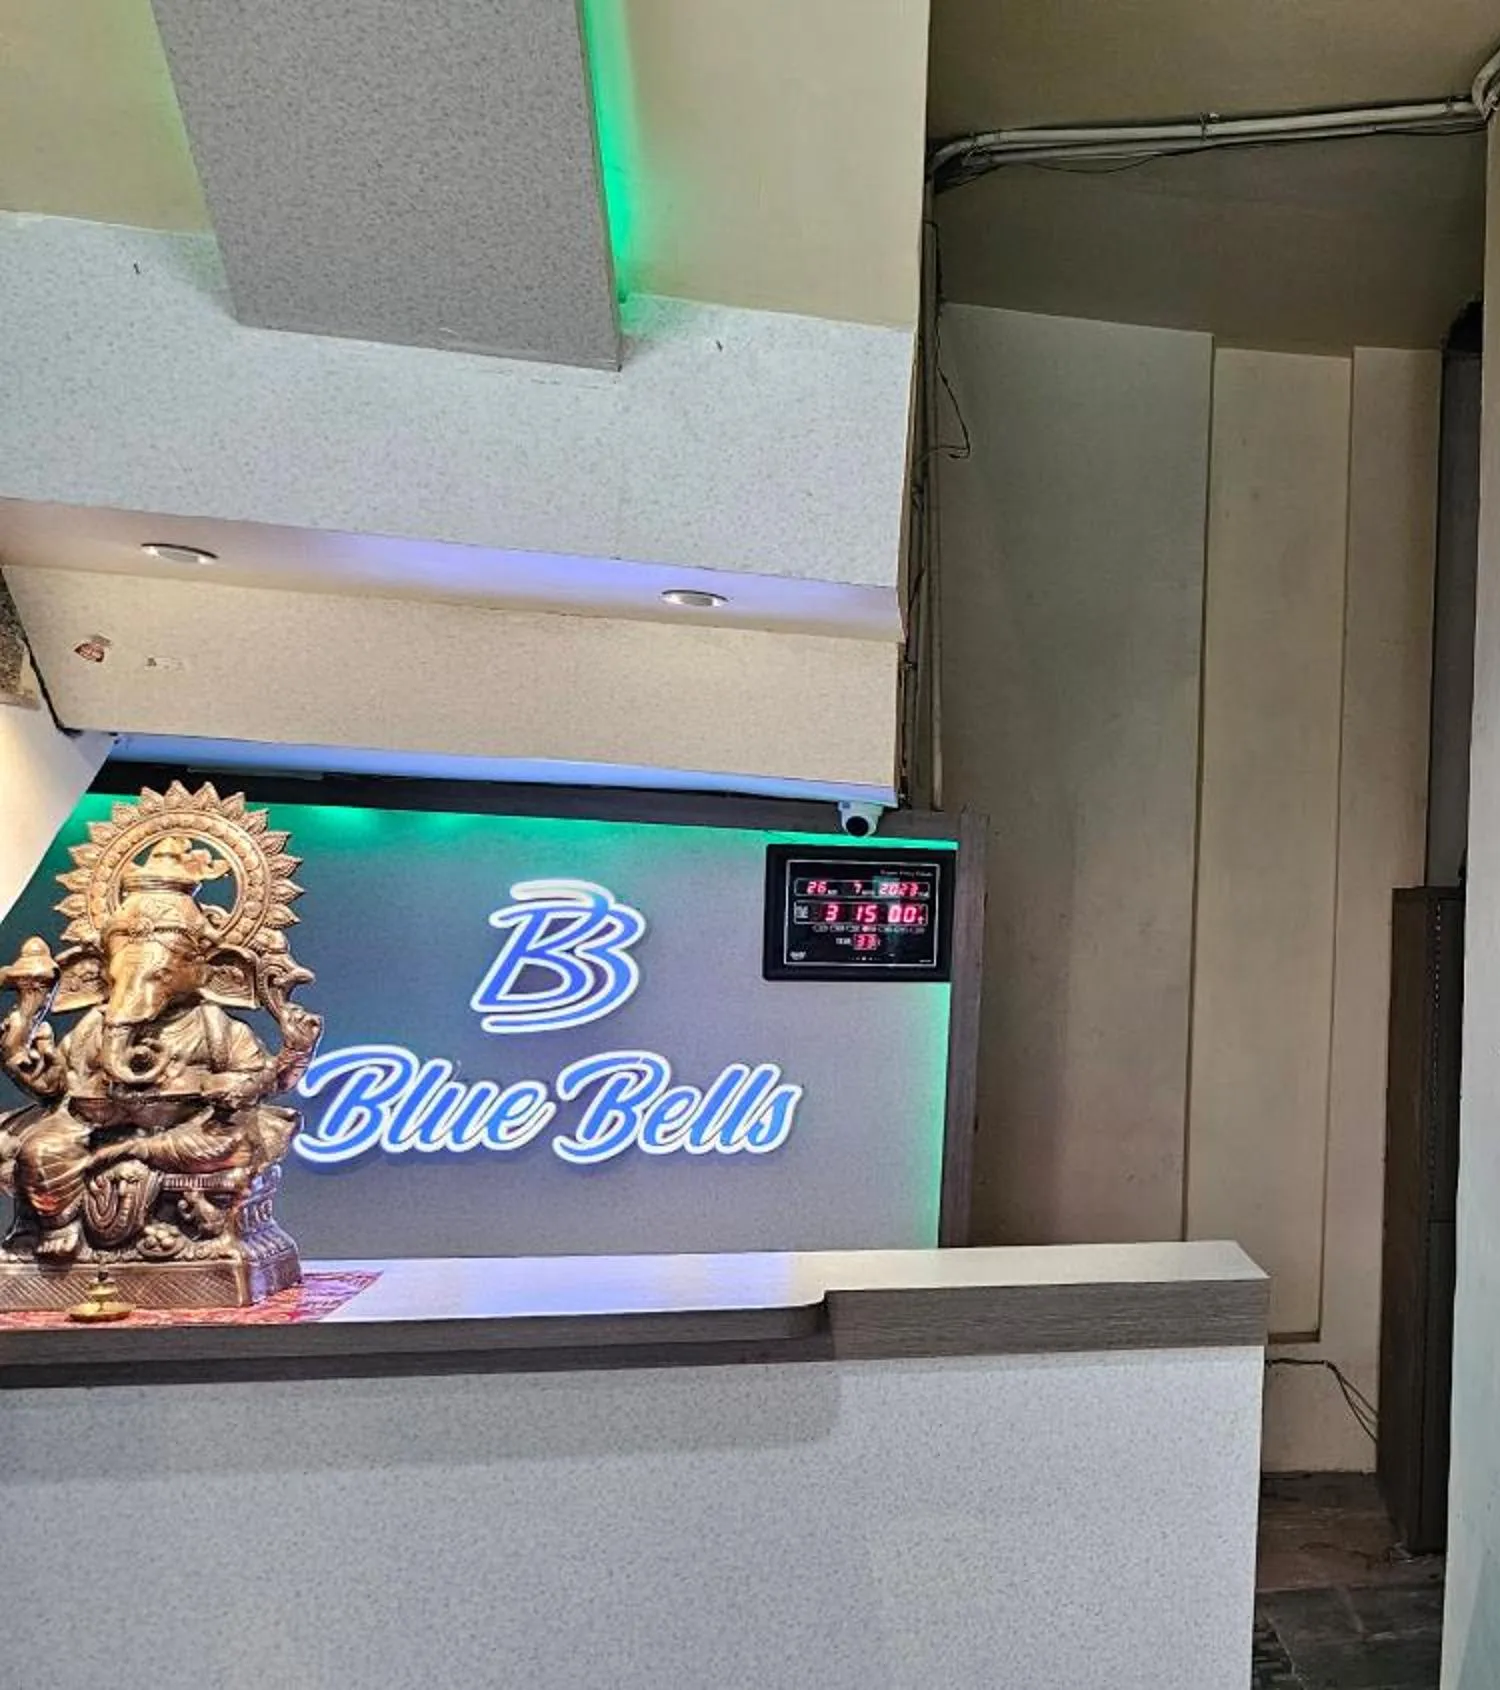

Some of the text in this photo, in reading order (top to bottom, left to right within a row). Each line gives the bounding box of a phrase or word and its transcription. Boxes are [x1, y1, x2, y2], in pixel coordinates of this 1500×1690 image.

[806, 881, 828, 894] 26
[854, 882, 862, 894] 7
[879, 882, 919, 897] 2023
[825, 904, 839, 922] 3
[856, 904, 877, 922] 15
[888, 904, 917, 923] 00
[293, 1045, 802, 1164] Blue Bells
